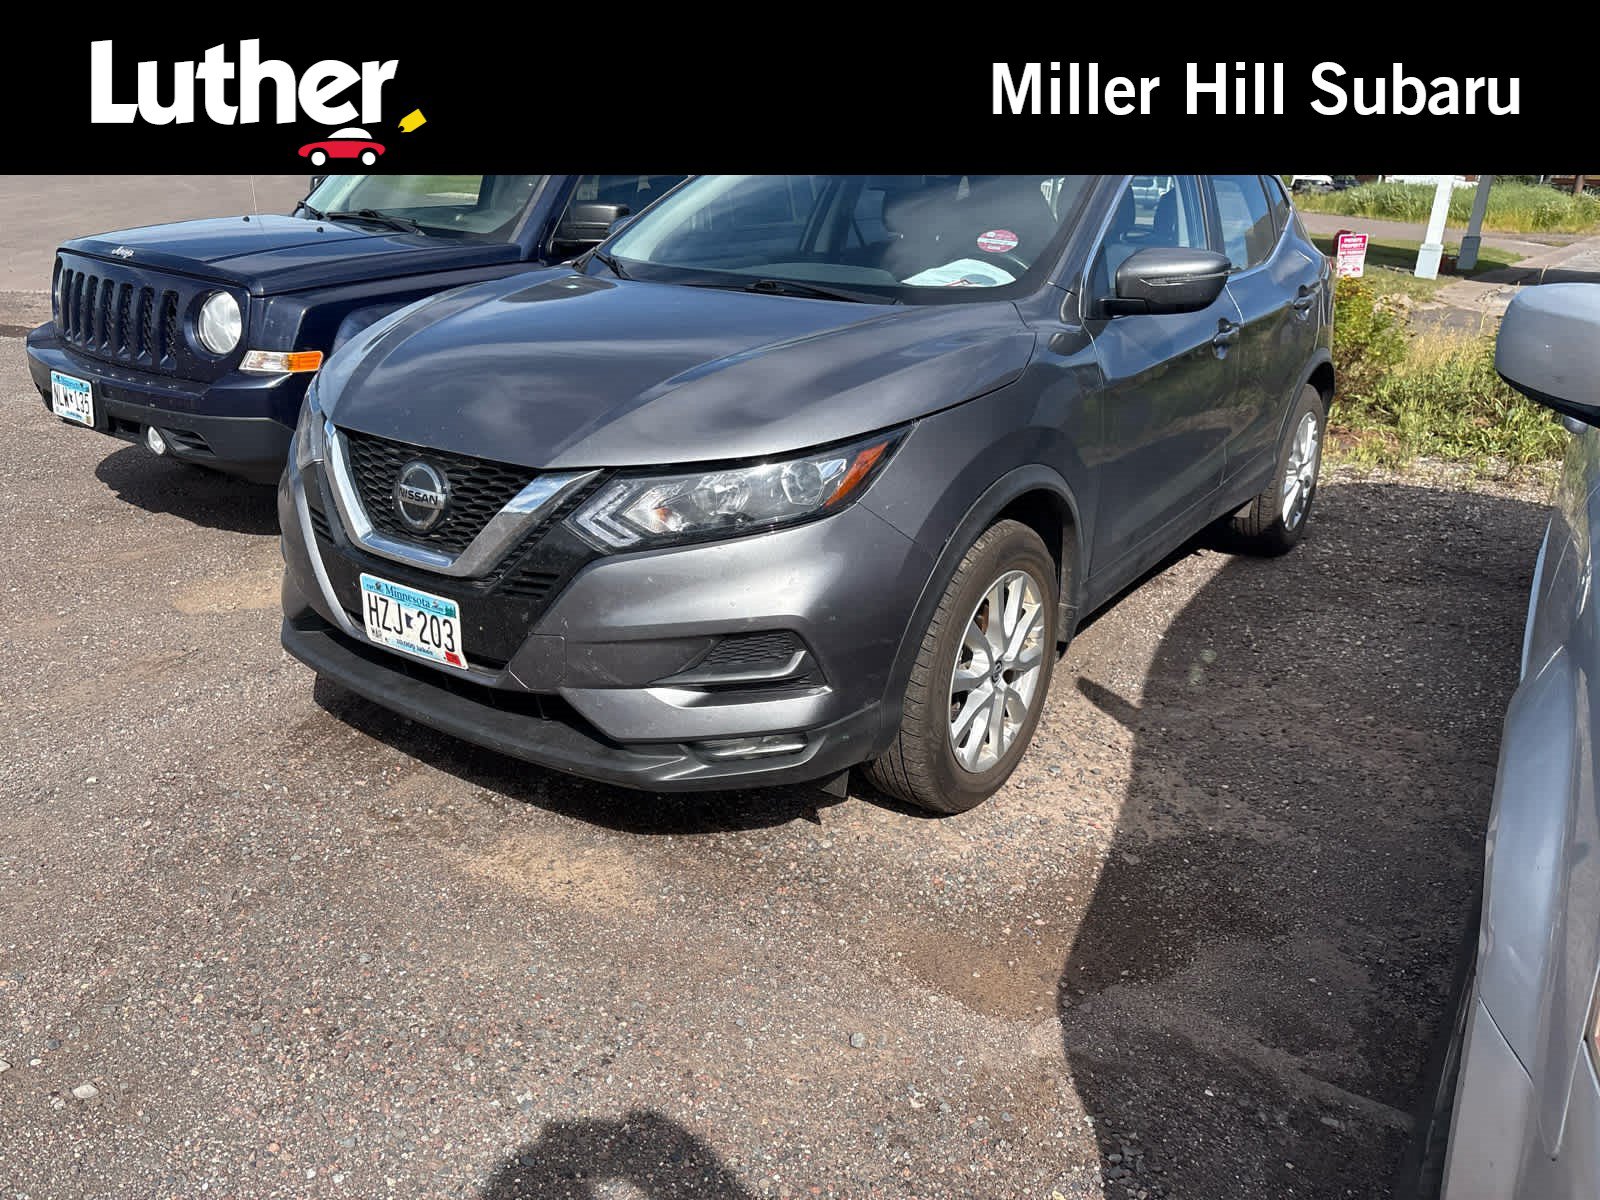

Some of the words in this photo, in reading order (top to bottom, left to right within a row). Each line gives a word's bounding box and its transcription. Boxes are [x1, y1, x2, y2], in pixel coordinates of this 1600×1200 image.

[400, 486, 438, 506] NISSAN
[384, 582, 431, 608] Minnesota
[367, 592, 403, 635] HZJ
[417, 610, 455, 653] 203
